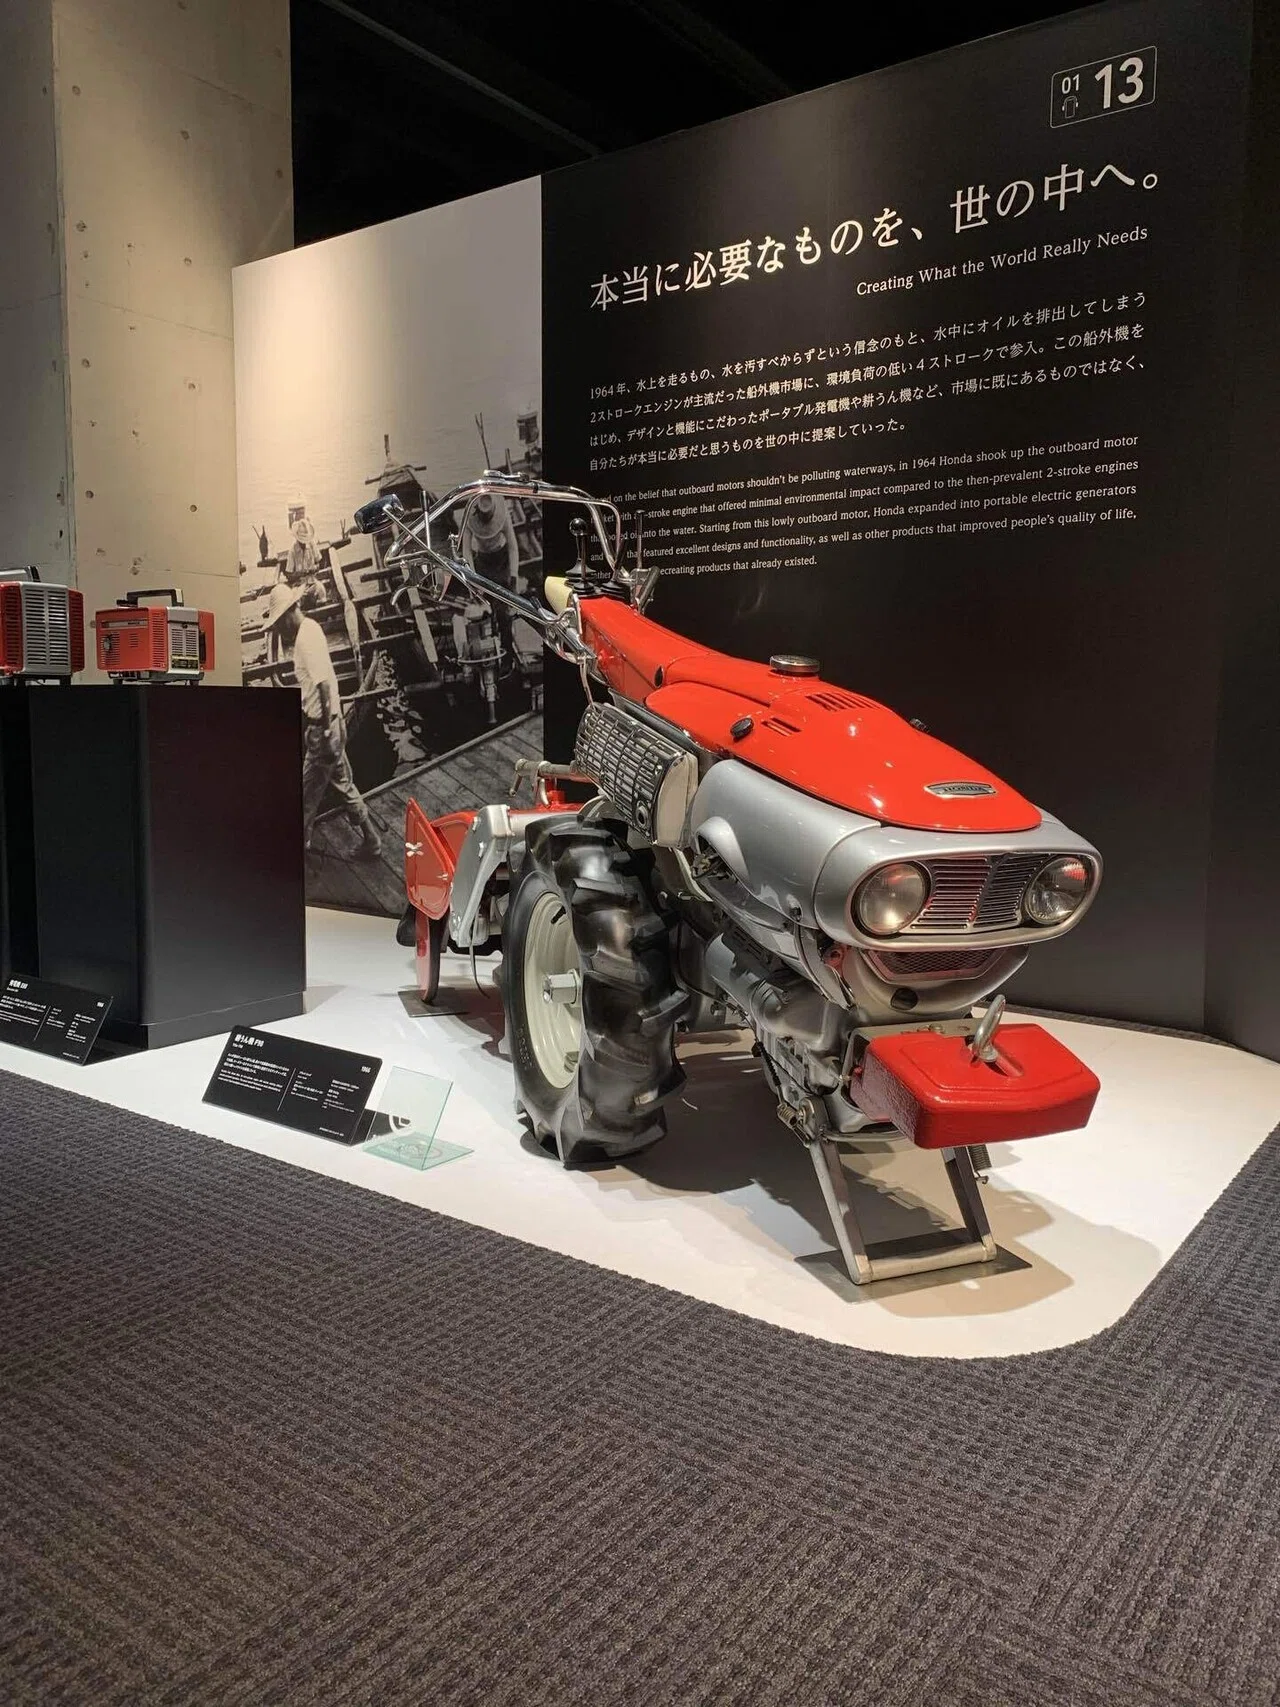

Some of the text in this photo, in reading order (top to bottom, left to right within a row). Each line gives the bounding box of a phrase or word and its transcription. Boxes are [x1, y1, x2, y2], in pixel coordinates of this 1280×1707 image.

[1062, 73, 1081, 95] 01
[1094, 56, 1144, 110] 13
[590, 163, 1159, 311] 本当に必要なものを、世の中へ。
[856, 226, 1148, 296] Creating What the World Really Needs
[613, 494, 623, 503] on
[624, 492, 637, 502] the
[638, 489, 660, 500] belief
[661, 488, 677, 498] that
[678, 482, 715, 496] outboard
[716, 481, 745, 492] motors
[746, 475, 786, 488] shouldn't
[788, 473, 799, 484] be
[801, 469, 841, 484] polluting
[843, 464, 896, 477] waterways,
[899, 460, 908, 471] in
[912, 456, 936, 469] 1964
[939, 453, 973, 466] Honda
[976, 449, 1007, 462] shook
[1010, 449, 1024, 461] up
[1028, 445, 1045, 457] the
[1048, 438, 1100, 454] outboard
[1103, 436, 1139, 448] motor
[644, 508, 671, 518] -stroke
[672, 505, 698, 518] engine
[700, 503, 716, 514] that
[717, 499, 747, 512] offered
[749, 495, 782, 508] minimal
[784, 488, 847, 505] environmental
[849, 486, 881, 499] impact
[883, 479, 931, 495] compared
[934, 480, 945, 489] to
[947, 477, 964, 488] the
[966, 469, 1043, 486] then-prevalent
[1046, 464, 1091, 478] 2-stroke
[1094, 460, 1139, 475] engines
[590, 551, 604, 561] and
[643, 545, 674, 558] featured
[675, 544, 710, 555] excellent
[711, 541, 741, 553] designs
[743, 538, 759, 550] and
[761, 535, 816, 548] functionality,
[818, 535, 829, 544] as
[831, 531, 850, 542] well
[852, 532, 863, 541] as
[864, 528, 890, 540] other
[892, 525, 934, 540] products
[937, 523, 956, 534] that
[960, 517, 1008, 533] improved
[1010, 514, 1055, 530] people's
[1057, 511, 1097, 526] quality
[1100, 508, 1113, 521] of
[1115, 507, 1137, 520] life,
[658, 527, 671, 537] the
[672, 526, 697, 535] water.
[699, 522, 731, 534] Starting
[732, 520, 752, 530] from
[754, 518, 770, 528] this
[771, 515, 795, 527] lowly
[797, 510, 838, 525] outboard
[840, 510, 871, 520] motor,
[873, 505, 905, 517] Honda
[908, 499, 957, 515] expanded
[960, 498, 981, 509] into
[983, 493, 1028, 510] portable
[1031, 489, 1072, 503] electric
[1075, 485, 1137, 502] generators
[660, 564, 695, 576] ecreating
[696, 562, 731, 575] products
[732, 560, 749, 571] that
[751, 558, 783, 570] already
[784, 555, 817, 567] existed.
